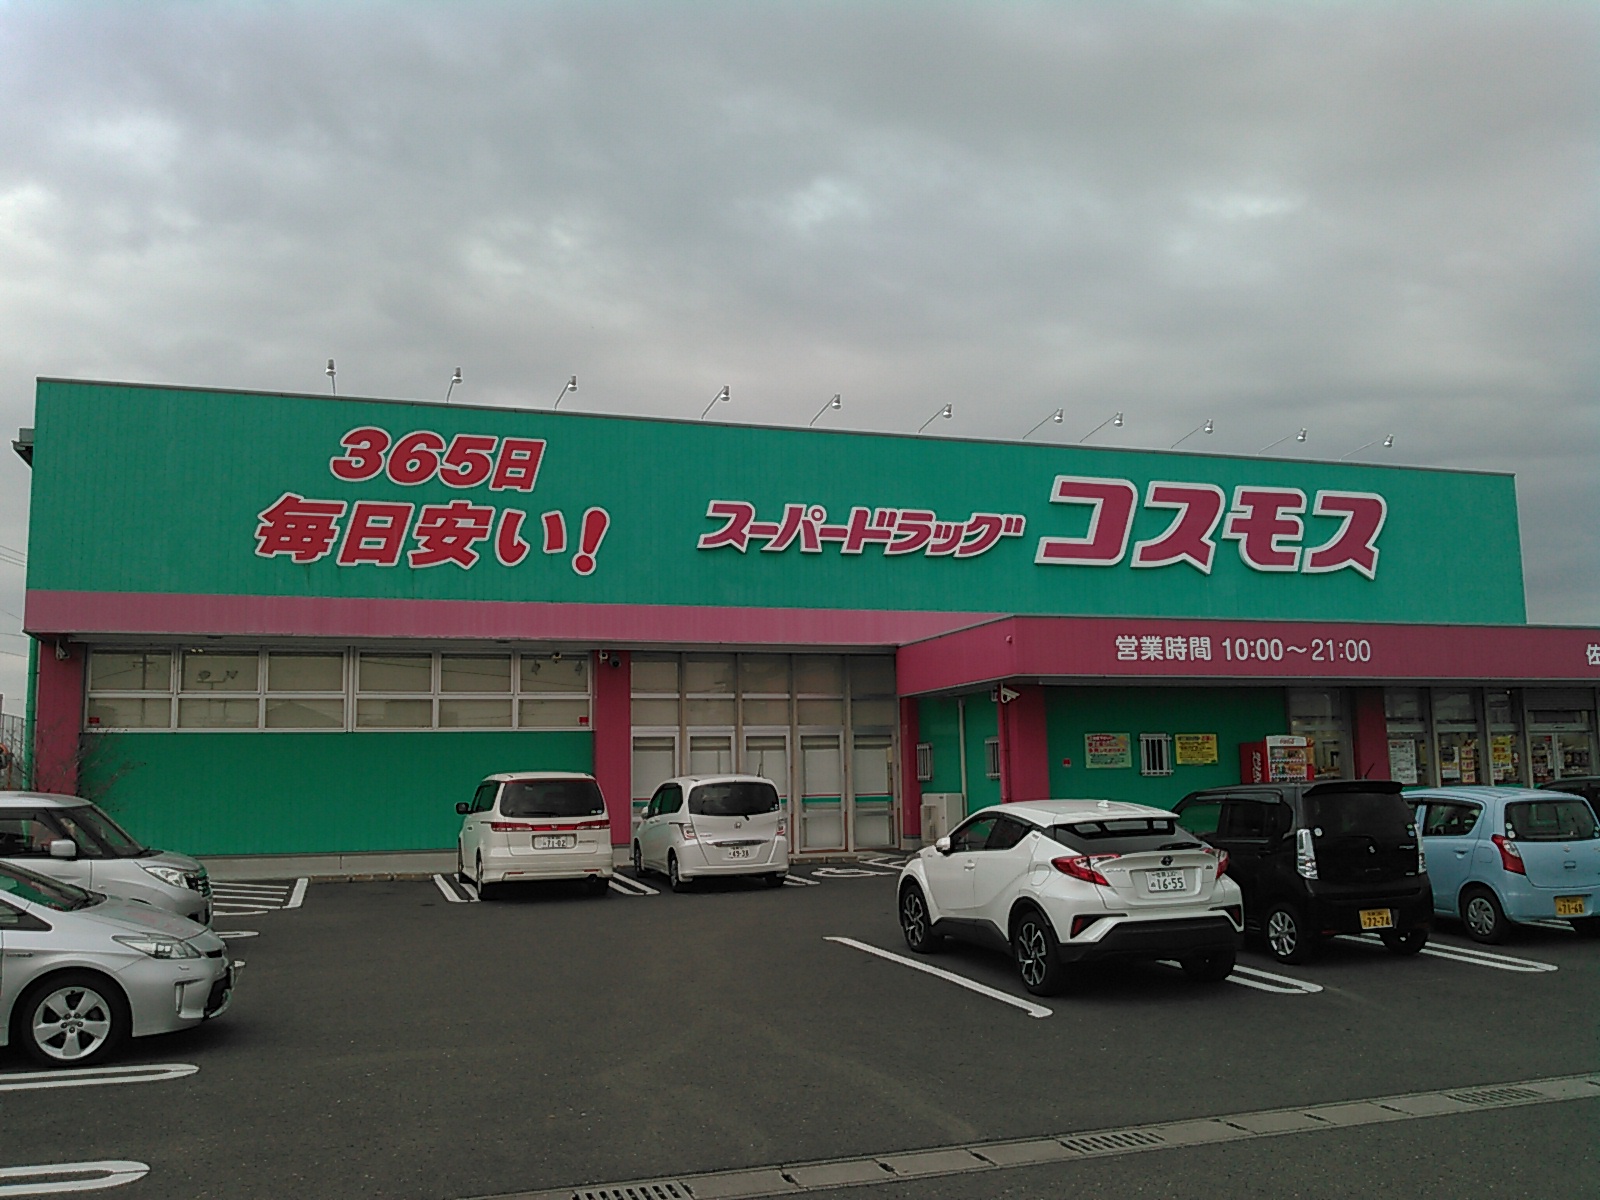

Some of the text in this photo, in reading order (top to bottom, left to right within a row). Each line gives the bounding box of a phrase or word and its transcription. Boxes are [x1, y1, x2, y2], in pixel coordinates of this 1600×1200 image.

[330, 426, 546, 492] 365日
[697, 475, 1387, 580] スーパードラッグ コスモス
[1115, 635, 1211, 661] 営業時間
